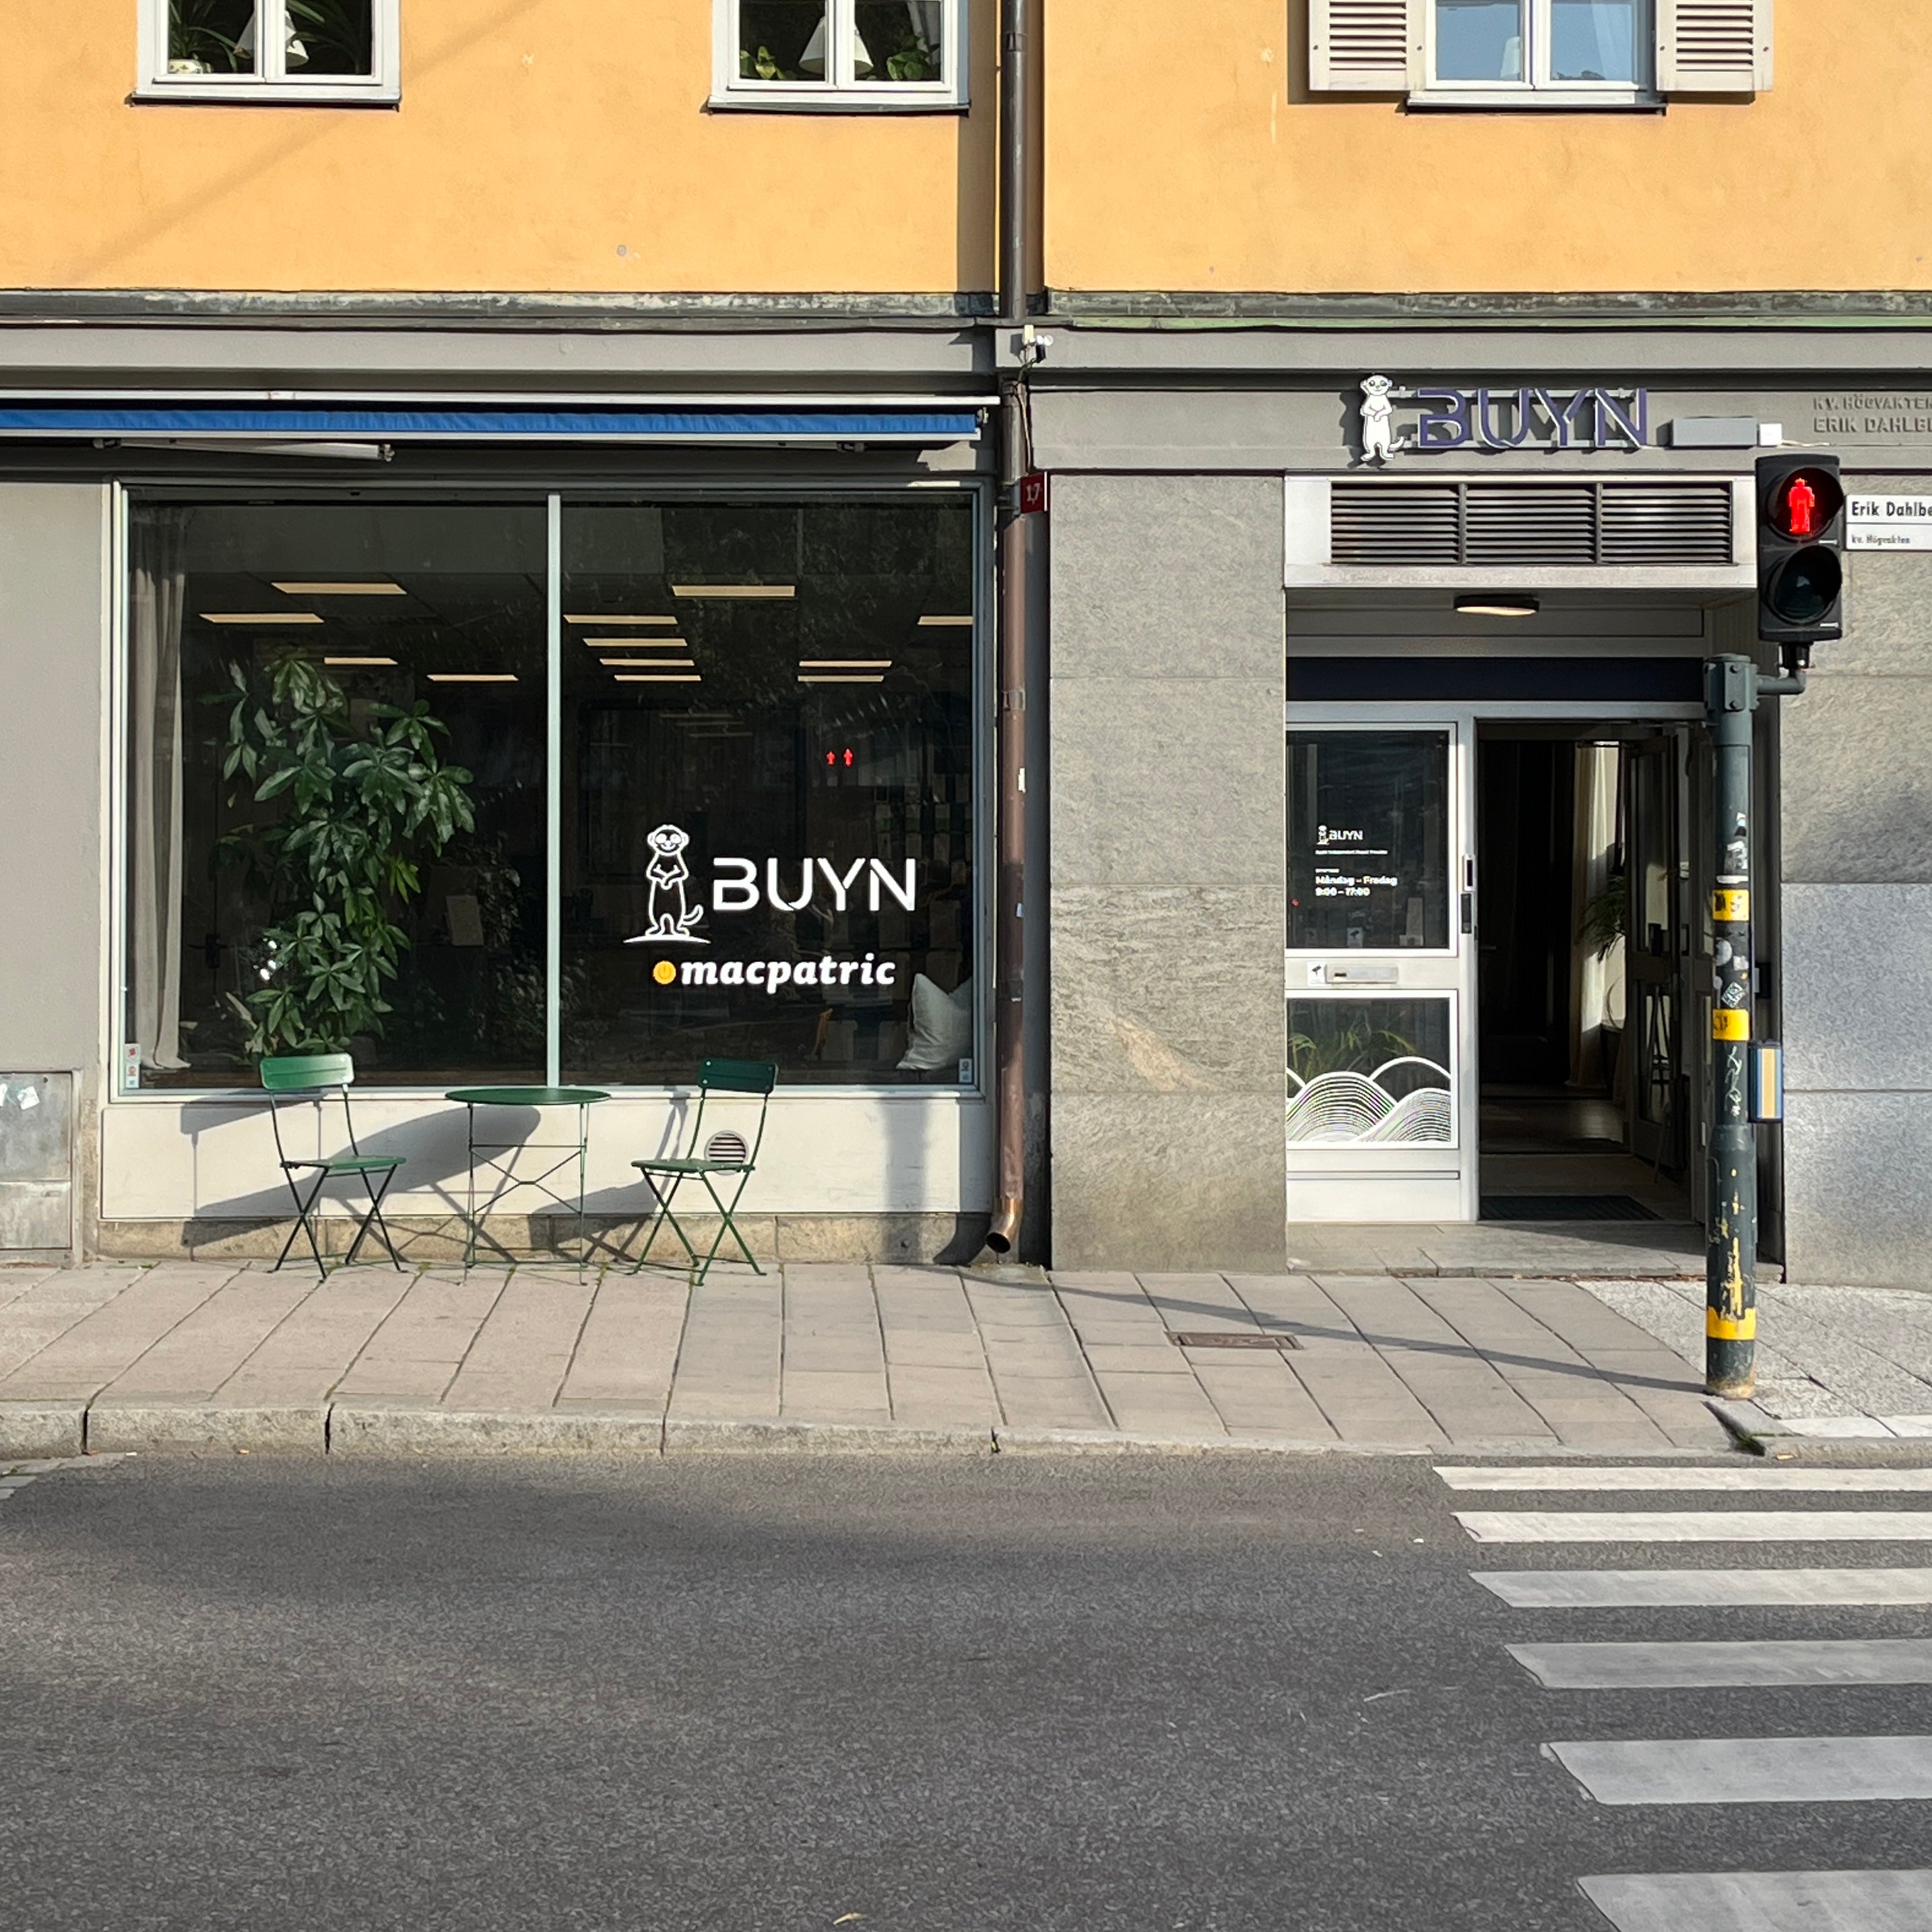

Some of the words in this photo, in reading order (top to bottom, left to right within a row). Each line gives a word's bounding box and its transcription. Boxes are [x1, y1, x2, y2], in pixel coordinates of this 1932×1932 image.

[1417, 388, 1647, 449] BUYN
[1813, 416, 1857, 433] ERIK
[1027, 482, 1041, 505] 17
[1852, 501, 1879, 517] Erik
[713, 857, 916, 912] BUYN
[680, 952, 897, 995] macpatric
